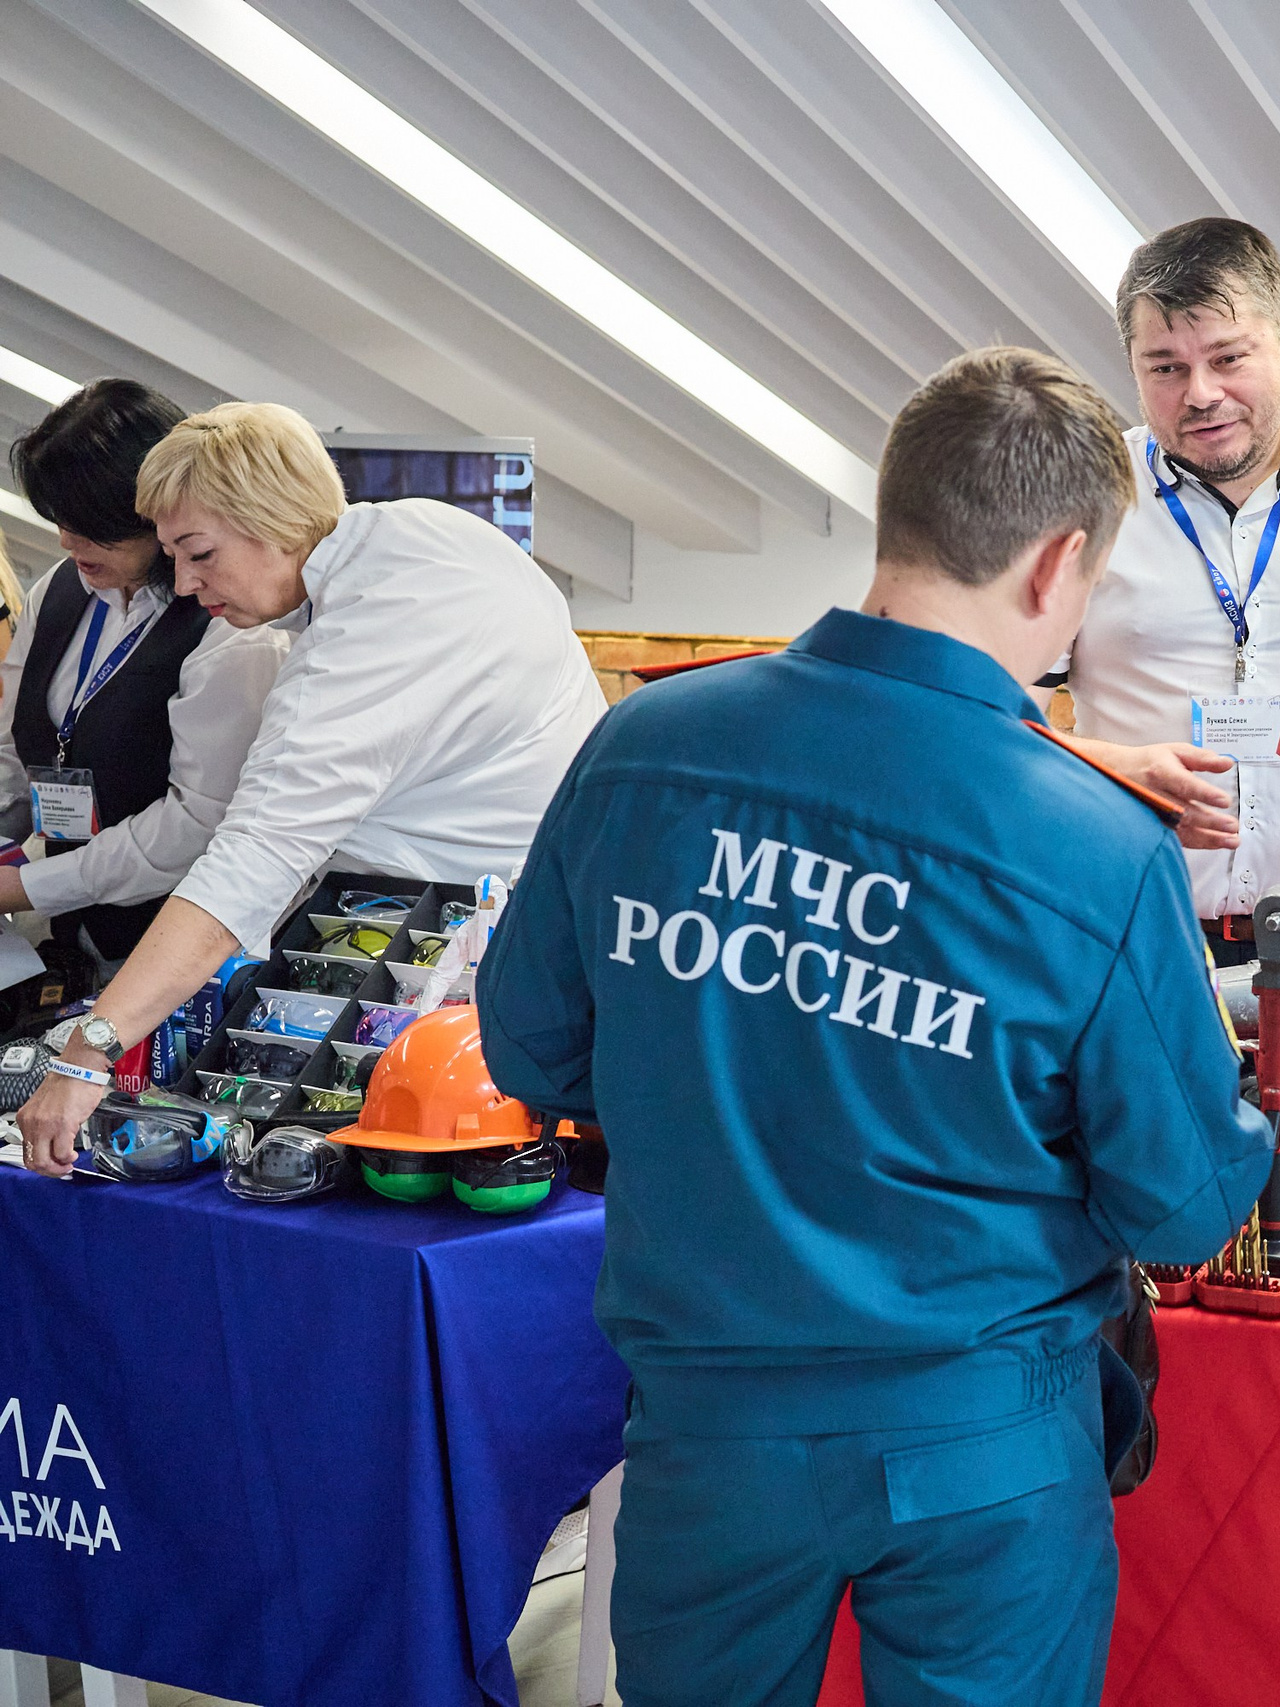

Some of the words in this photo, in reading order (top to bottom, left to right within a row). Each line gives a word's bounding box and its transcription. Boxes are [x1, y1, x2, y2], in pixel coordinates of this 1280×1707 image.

[1224, 600, 1239, 621] АСИЗ
[698, 828, 911, 946] МЧС
[608, 895, 986, 1059] РОССИИ
[203, 1002, 212, 1046] ARDA
[53, 1063, 82, 1076] РАБОТАЙ
[152, 1031, 161, 1079] GARDA
[116, 1074, 149, 1093] ARDA
[0, 1490, 121, 1556] ДЕЖДА
